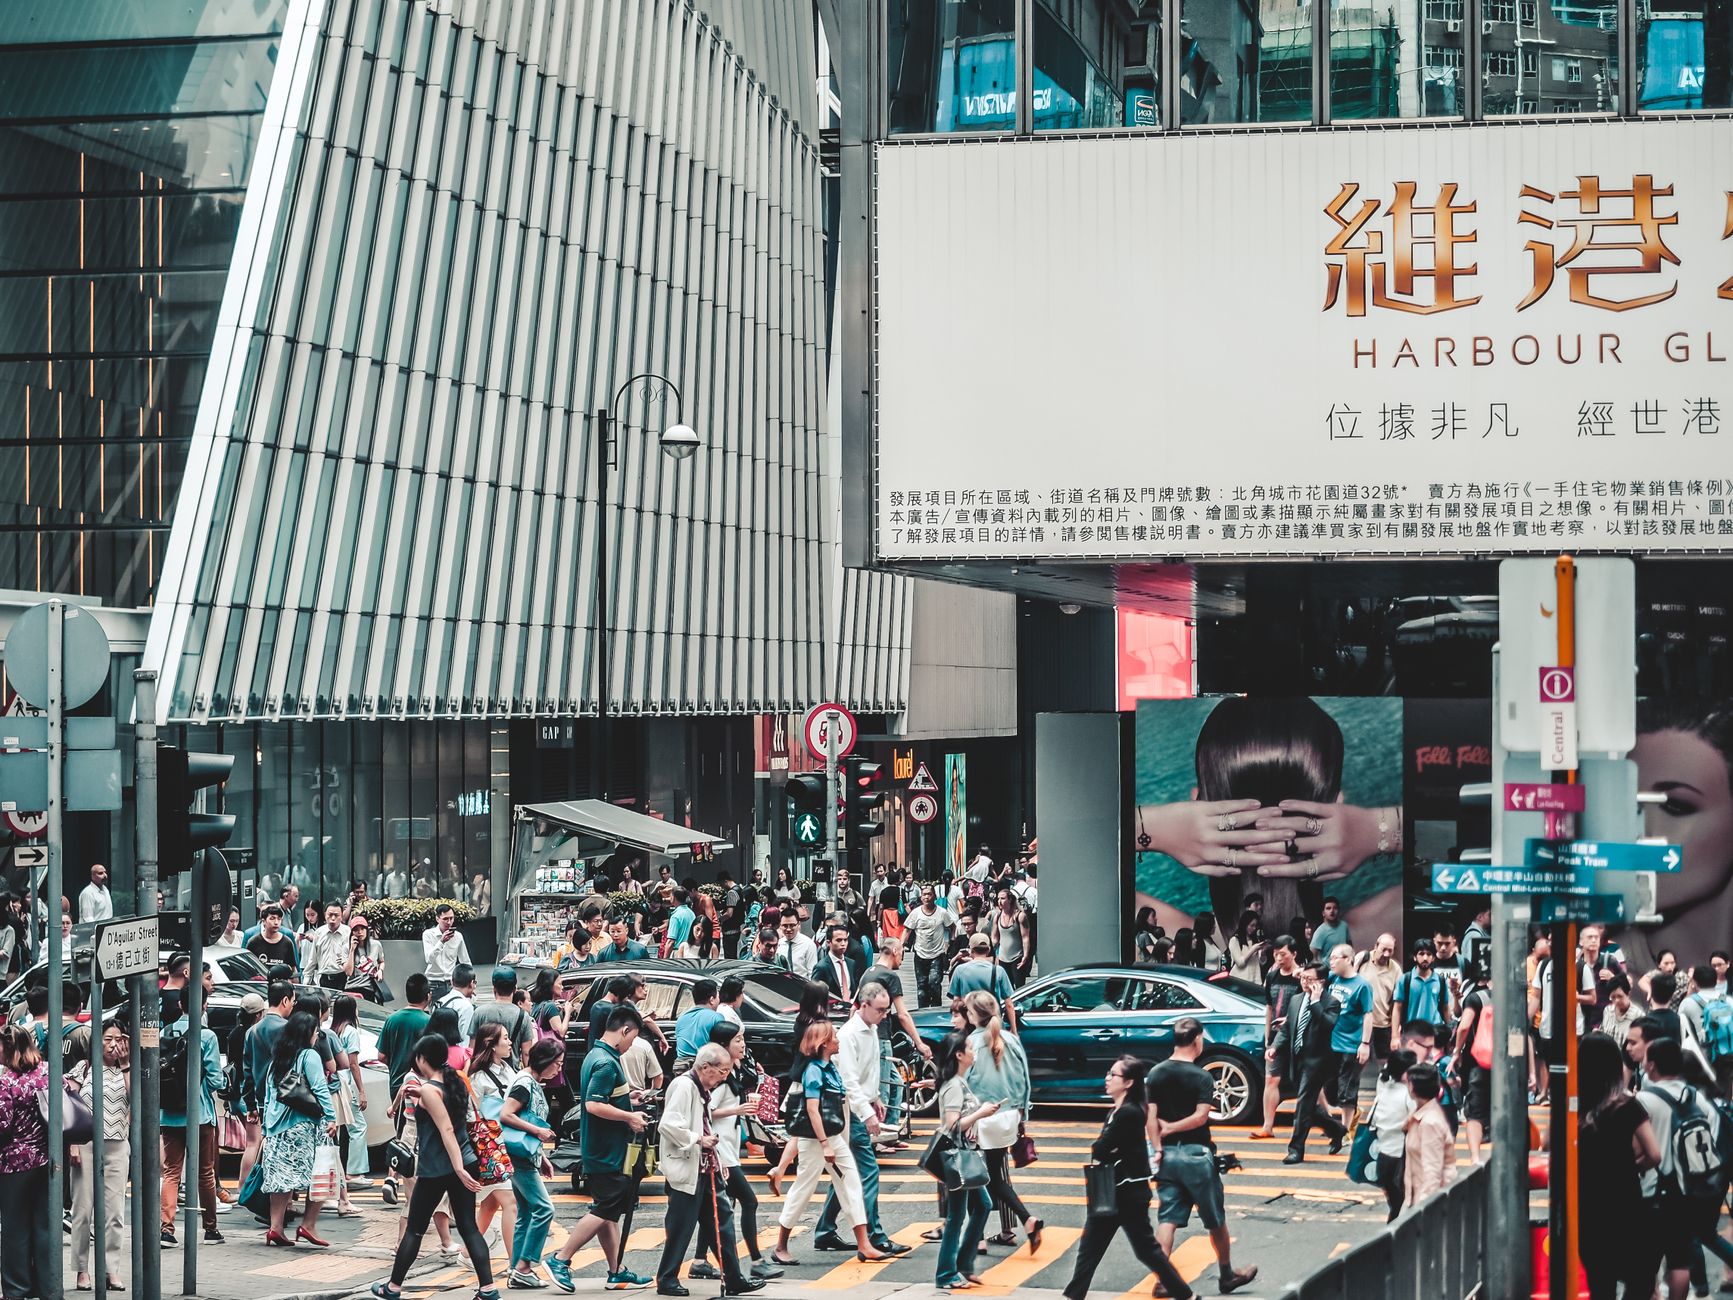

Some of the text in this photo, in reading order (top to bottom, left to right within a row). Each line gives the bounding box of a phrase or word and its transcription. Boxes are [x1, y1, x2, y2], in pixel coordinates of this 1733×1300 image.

[1354, 333, 1623, 369] HARBOUR
[1325, 396, 1721, 441] 位據非凡 經世港
[542, 726, 560, 740] GAP
[1551, 710, 1563, 765] Central
[1416, 745, 1452, 773] Folli
[1558, 856, 1608, 867] Peak Tram
[1482, 884, 1510, 893] Central
[107, 925, 158, 946] D'Aguilar Street
